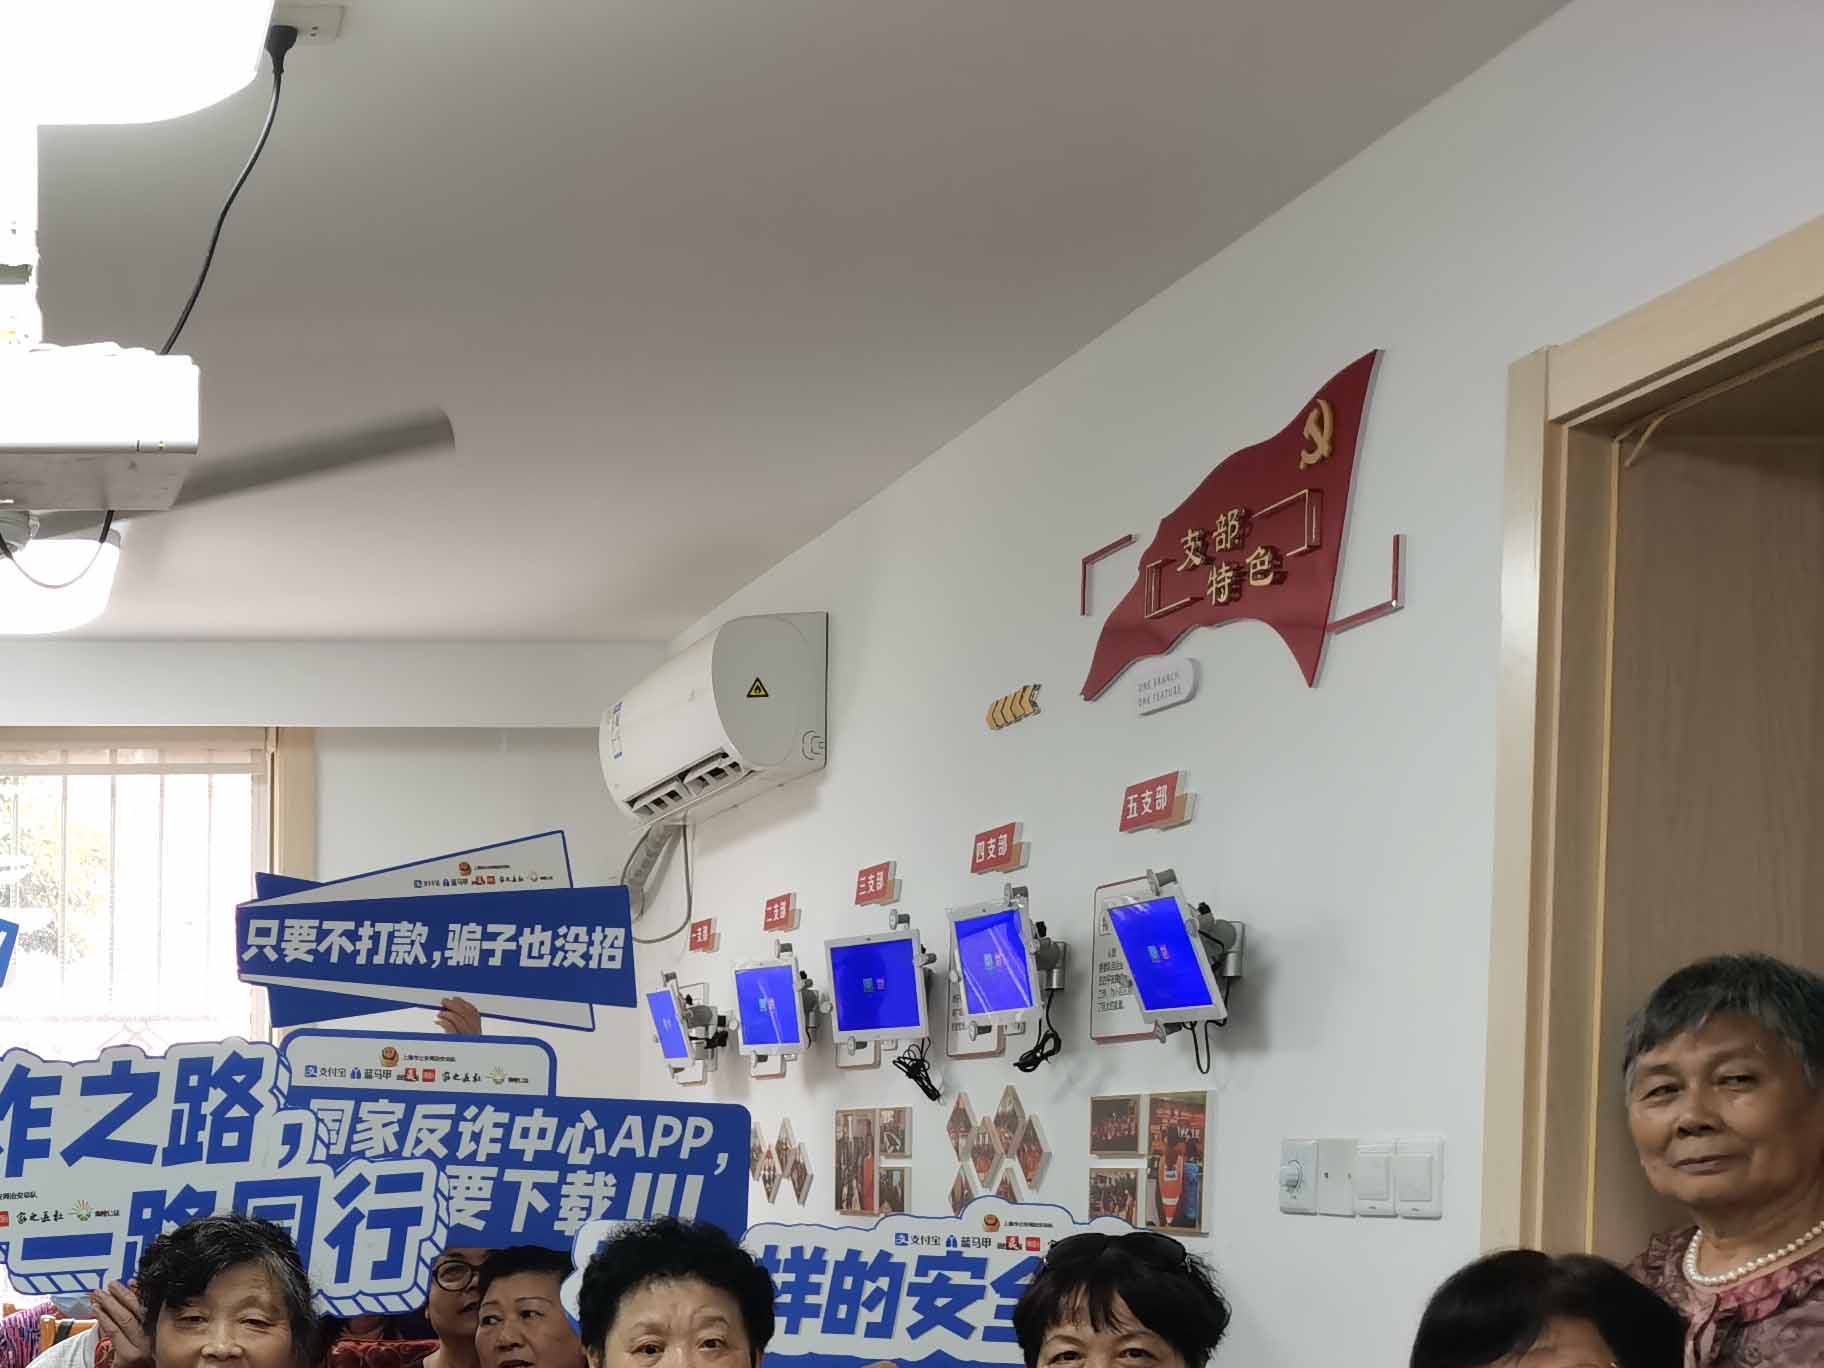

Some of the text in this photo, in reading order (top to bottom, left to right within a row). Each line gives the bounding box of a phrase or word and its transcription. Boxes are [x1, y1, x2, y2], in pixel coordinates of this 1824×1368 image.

[1177, 507, 1244, 572] 支部
[1206, 546, 1275, 606] 特色
[1125, 784, 1169, 820] 五支部
[976, 834, 1008, 864] 四支部
[859, 872, 884, 896] 三支部
[765, 901, 787, 922] 二支部
